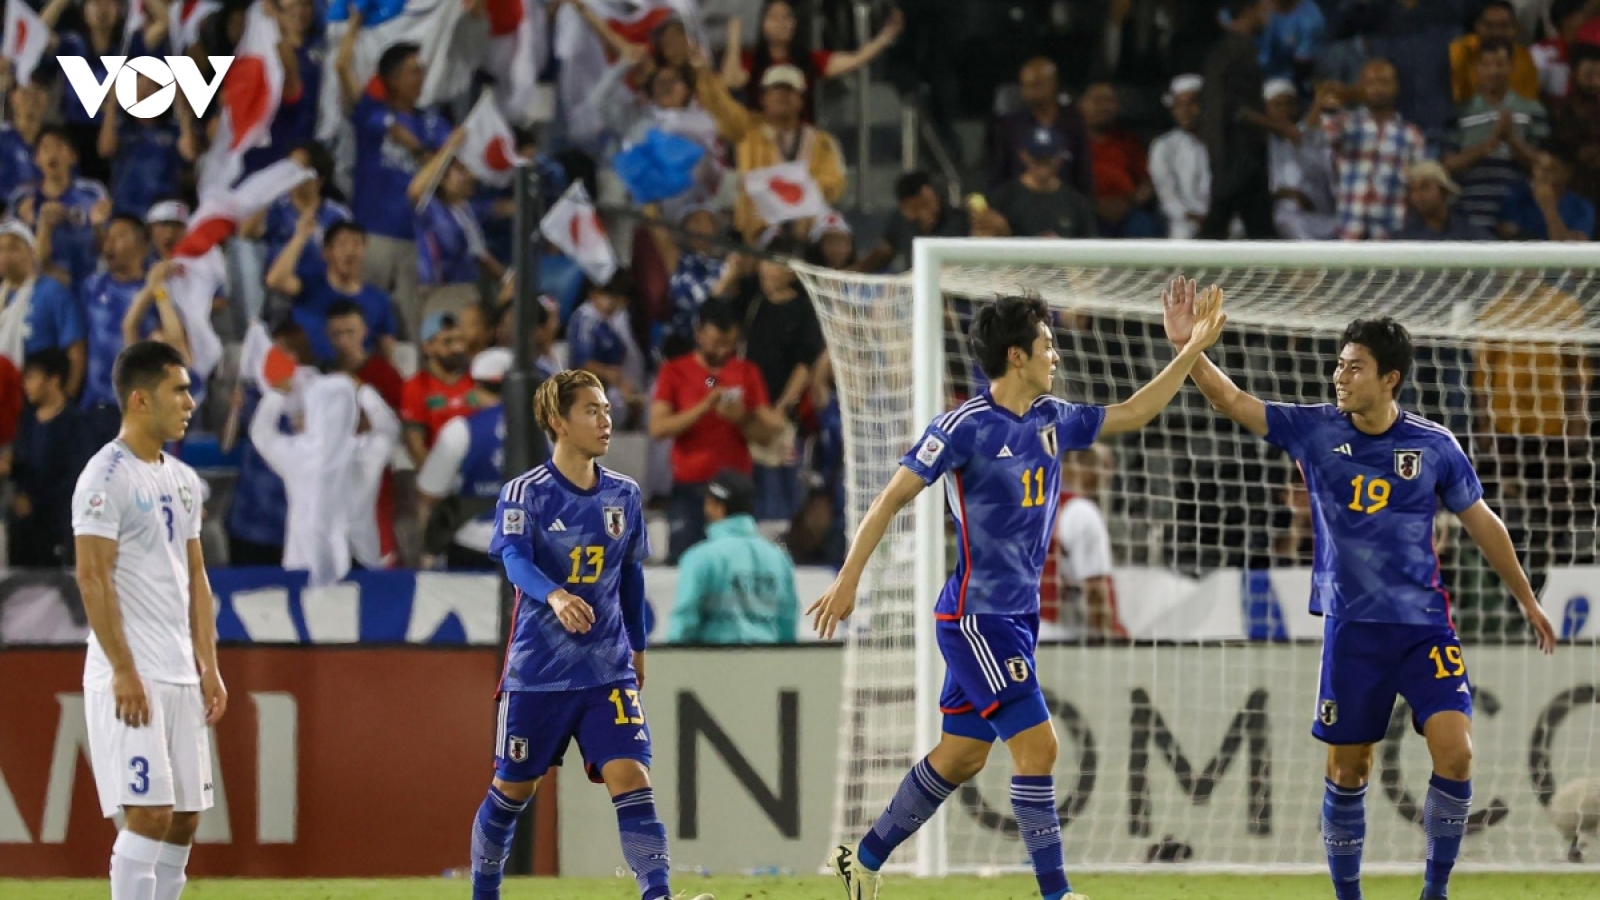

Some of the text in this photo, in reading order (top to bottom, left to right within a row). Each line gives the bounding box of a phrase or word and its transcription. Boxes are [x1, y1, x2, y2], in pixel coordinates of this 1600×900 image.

[1021, 466, 1045, 507] 11
[1348, 474, 1391, 514] 19
[567, 546, 605, 583] 13
[1428, 646, 1465, 679] 19
[608, 688, 645, 725] 13
[129, 755, 149, 796] 3
